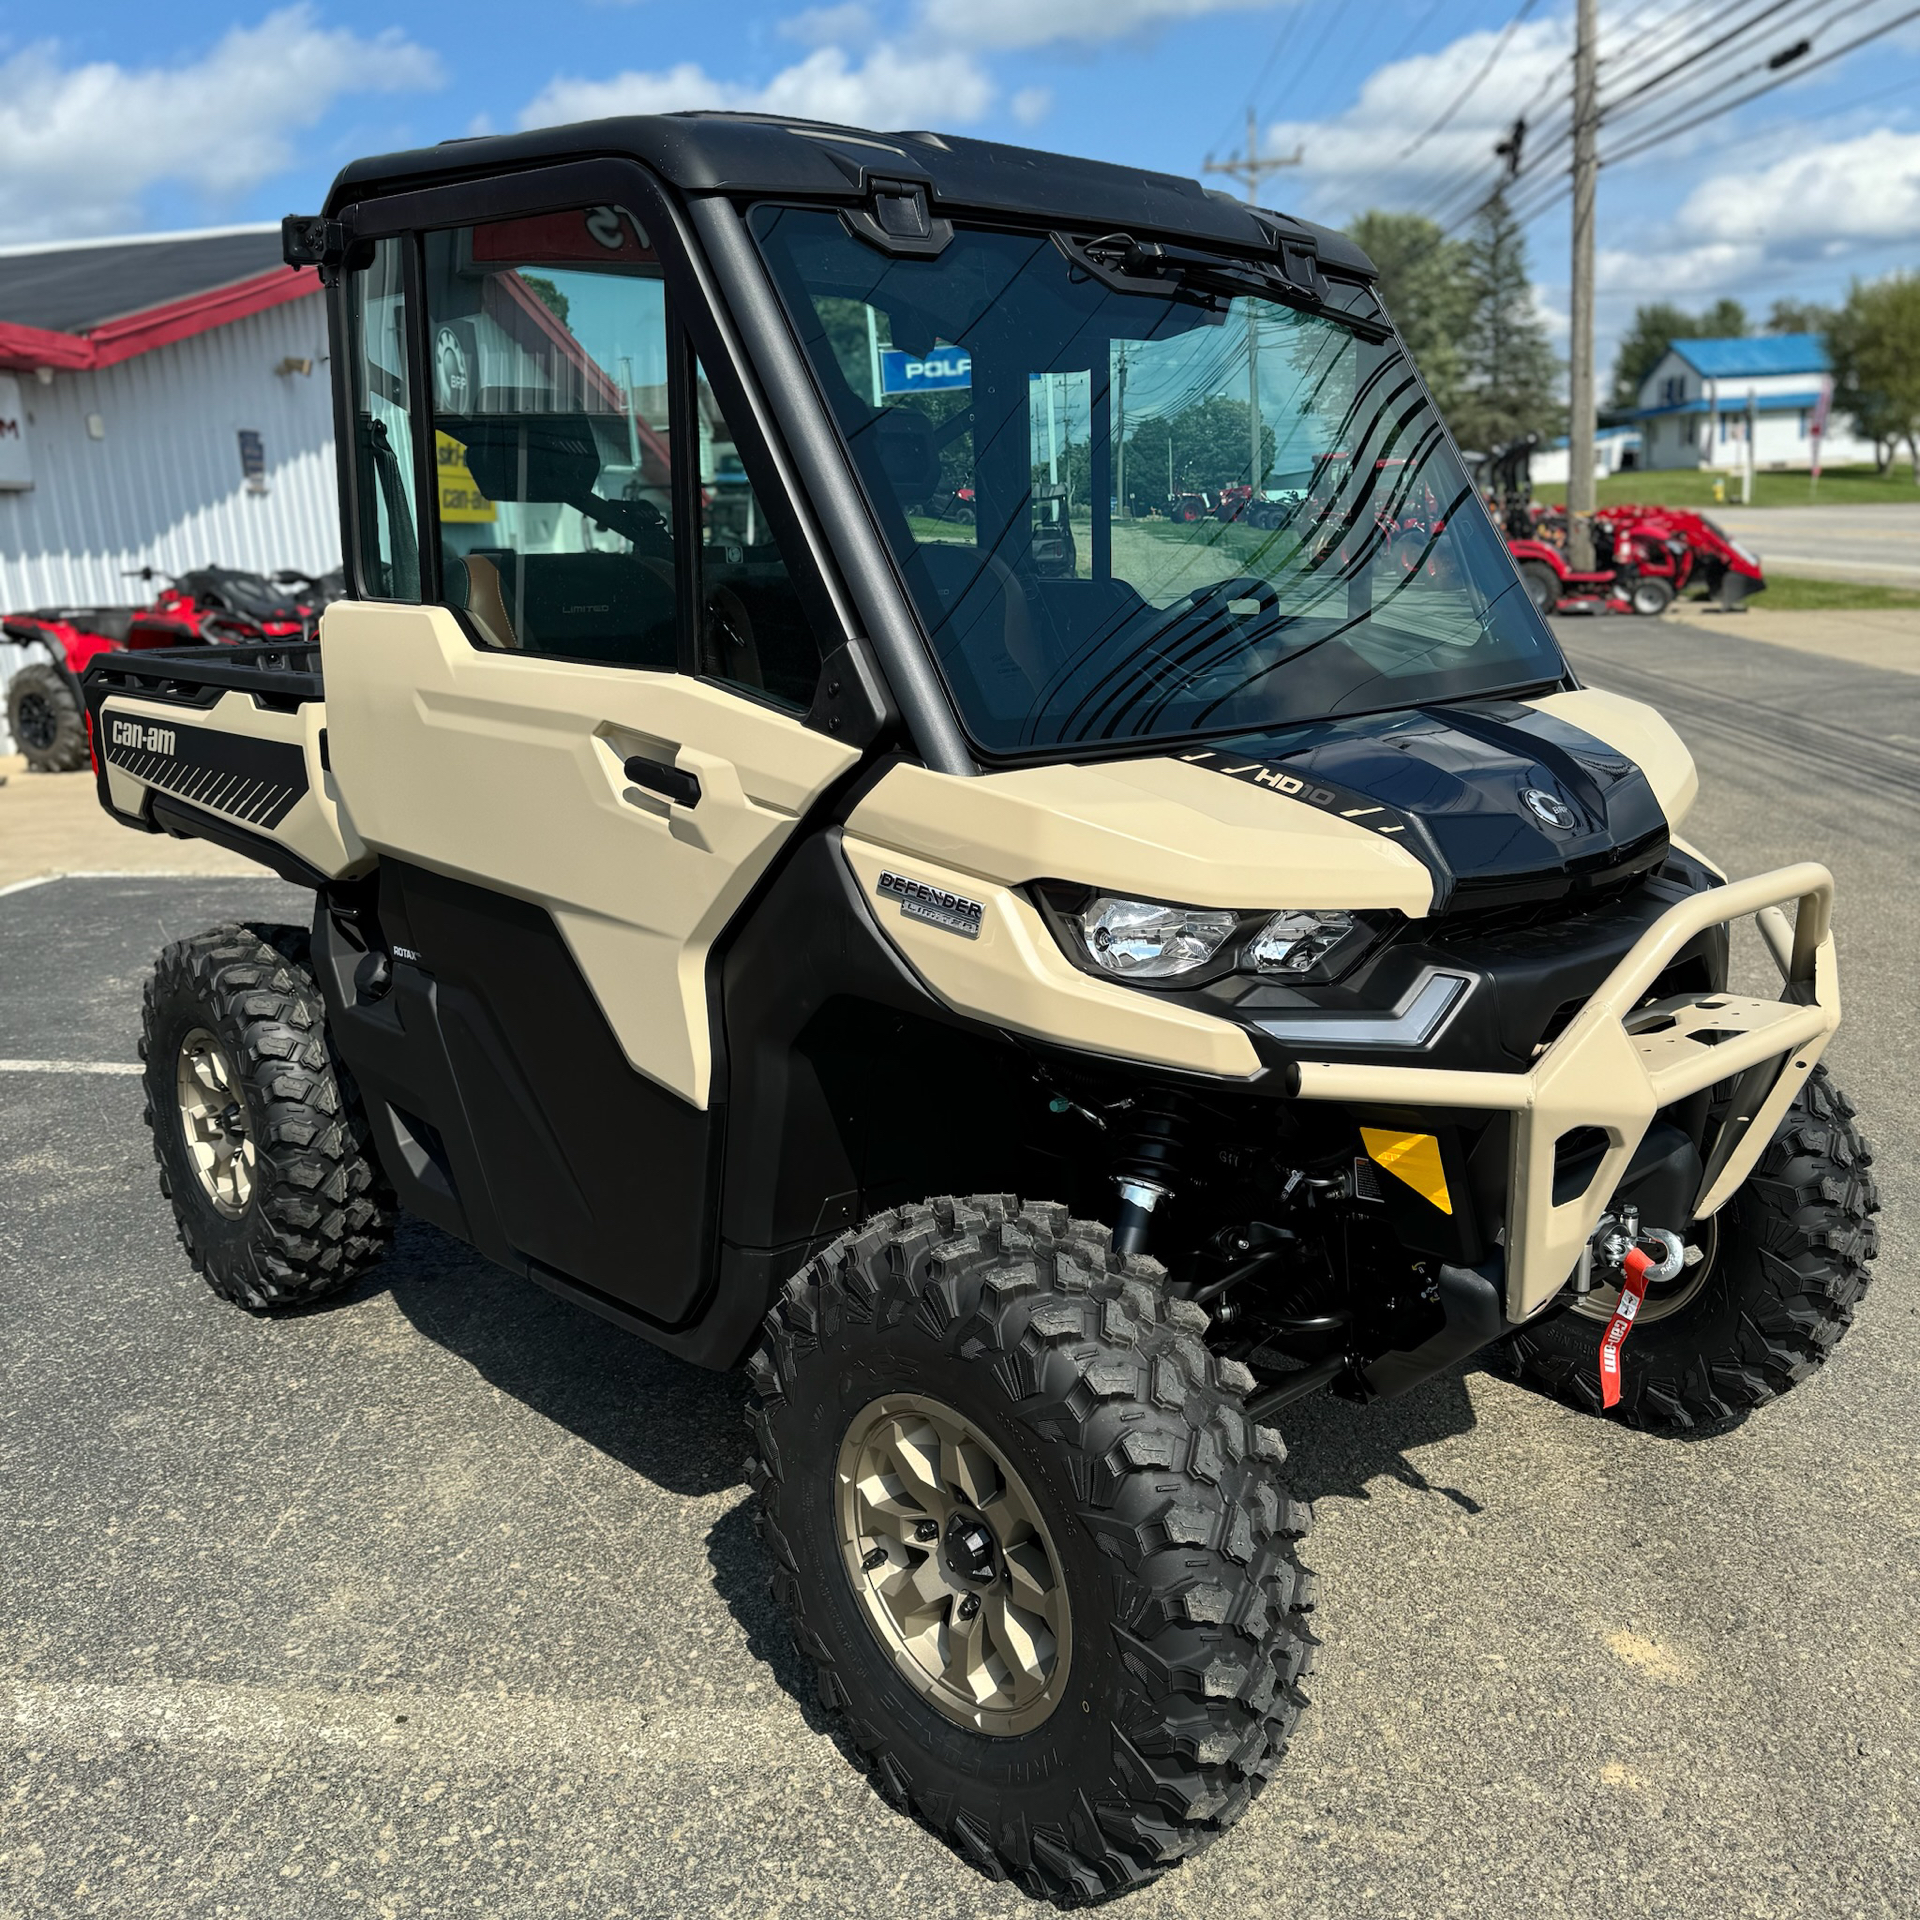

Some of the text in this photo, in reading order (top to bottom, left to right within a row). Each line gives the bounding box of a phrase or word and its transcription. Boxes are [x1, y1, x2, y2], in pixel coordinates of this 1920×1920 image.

[113, 720, 176, 756] can-am
[1254, 768, 1336, 805] HD10
[880, 872, 982, 918] DEFENDER
[393, 945, 417, 961] ROTAX
[1603, 1319, 1628, 1373] can-am
